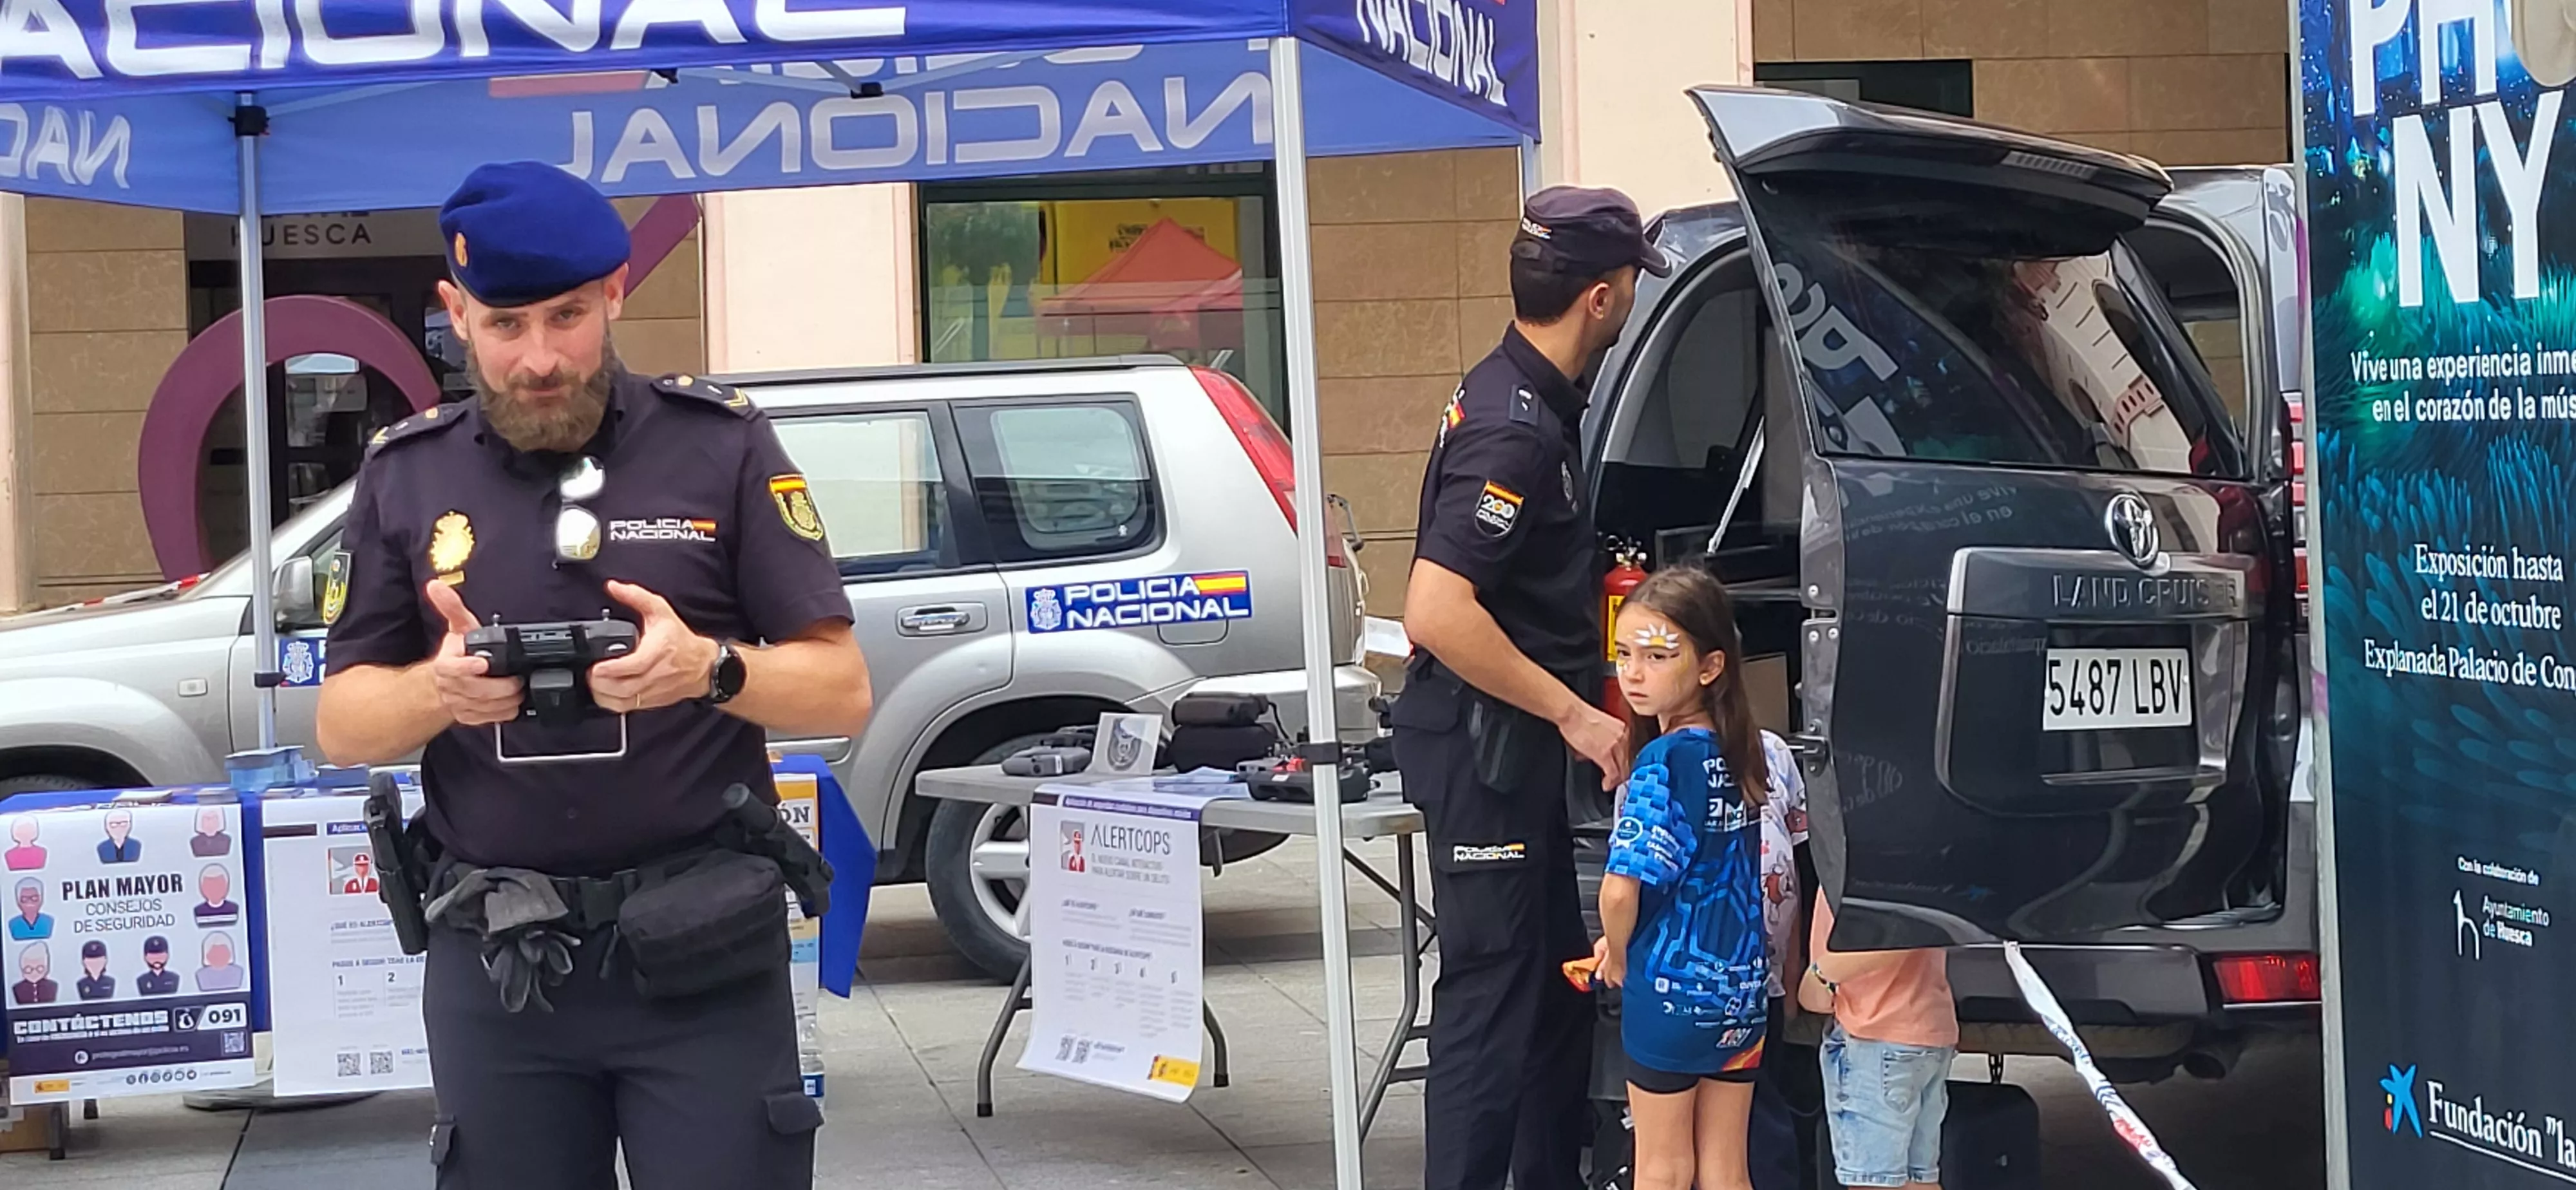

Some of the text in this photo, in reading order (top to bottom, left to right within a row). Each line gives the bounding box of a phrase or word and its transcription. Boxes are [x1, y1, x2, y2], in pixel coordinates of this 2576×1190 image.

[2349, 0, 2512, 117] PH
[2392, 90, 2564, 308] NY
[2351, 350, 2389, 381] Vive
[2390, 358, 2422, 381] una
[2427, 343, 2532, 387] experiencia
[2372, 402, 2391, 422] en
[2394, 393, 2409, 420] el
[2415, 392, 2485, 422] corazón
[2488, 394, 2511, 421] de
[2517, 386, 2536, 420] la
[610, 518, 694, 530] POLICIA
[611, 529, 715, 542] NACIONAL
[2414, 543, 2564, 582] Exposición hasta
[1063, 575, 1200, 606] POLICIA
[2052, 574, 2131, 608] LAND
[1066, 596, 1249, 629] NACIONAL
[2421, 587, 2562, 630] el 21 de octubre
[2364, 639, 2576, 697] Explanada Palacio de Con
[2049, 657, 2183, 716] 5487 LBV
[1091, 824, 1171, 855] ALERTCOPS
[1454, 852, 1525, 862] NACIONAL
[62, 873, 183, 900] PLAN MAYOR
[75, 913, 176, 933] DE SEGURIDAD
[86, 899, 163, 916] CONSEJOS
[2482, 895, 2550, 926] Ayuntamiento
[2483, 920, 2533, 947] de Huesca
[337, 975, 344, 986] 1
[387, 972, 395, 983] 2
[13, 1009, 169, 1035] CONTÁCTENOS
[208, 1008, 241, 1024] 091
[2427, 1080, 2543, 1158] Fundación
